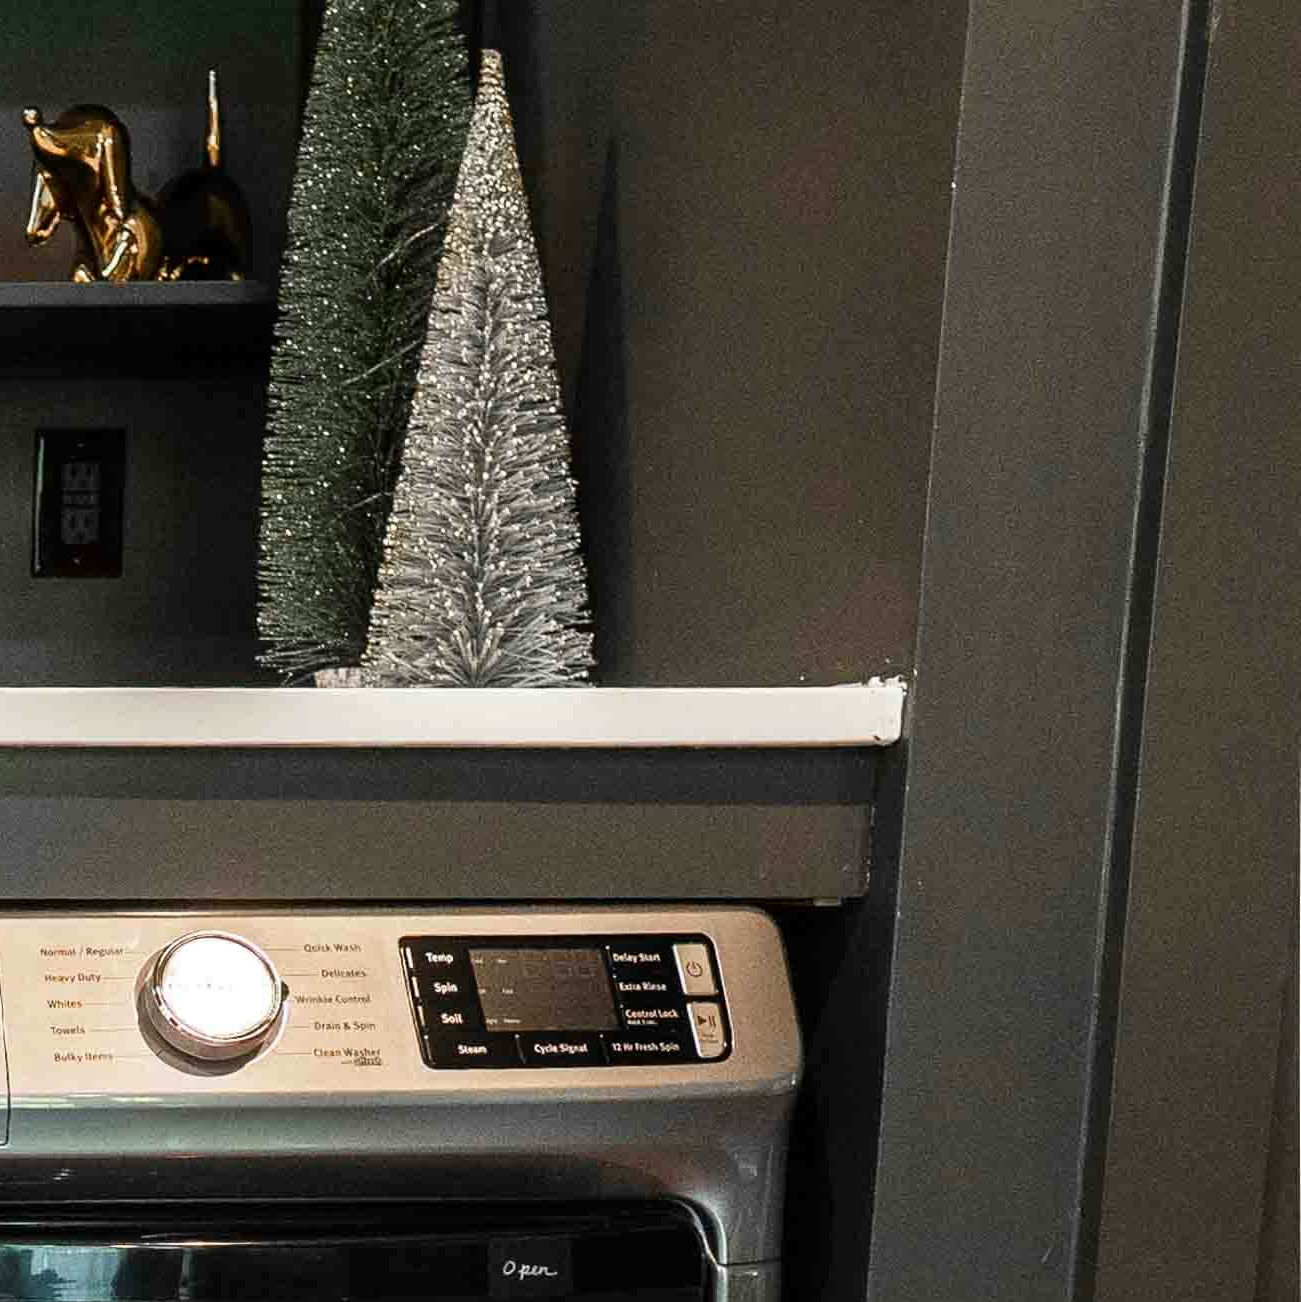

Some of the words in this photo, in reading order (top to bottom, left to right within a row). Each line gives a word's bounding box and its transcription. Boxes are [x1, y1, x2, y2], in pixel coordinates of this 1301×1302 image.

[40, 948, 77, 957] Normal
[85, 947, 124, 958] Regular
[303, 943, 331, 953] Quick
[333, 943, 363, 953] Wash
[425, 952, 454, 964] Temp
[612, 953, 638, 963] Delay
[639, 953, 661, 962] Start
[44, 974, 76, 983] Heavy
[77, 973, 102, 983] Duty
[321, 968, 368, 978] Delicates
[433, 982, 458, 994] Spin
[619, 982, 641, 991] Extra
[642, 981, 667, 991] Rinse
[47, 999, 83, 1009] Whites
[294, 995, 333, 1004] Wrinkle
[334, 994, 371, 1004] Control
[625, 1009, 658, 1018] Control
[658, 1009, 679, 1018] Lock
[440, 1013, 464, 1025] Soil
[50, 1026, 86, 1035] Towels
[314, 1021, 341, 1031] Drain
[342, 1021, 351, 1031] &
[353, 1021, 376, 1032] Spin
[313, 1048, 342, 1057] Clean
[342, 1047, 381, 1057] Washer
[457, 1044, 488, 1055] Steam
[533, 1043, 559, 1055] Cycle
[559, 1043, 589, 1055] Signal
[612, 1042, 622, 1052] 12
[634, 1042, 658, 1052] Fresh
[659, 1042, 680, 1052] Spin
[53, 1053, 83, 1063] Bulky
[502, 1260, 558, 1281] Open
